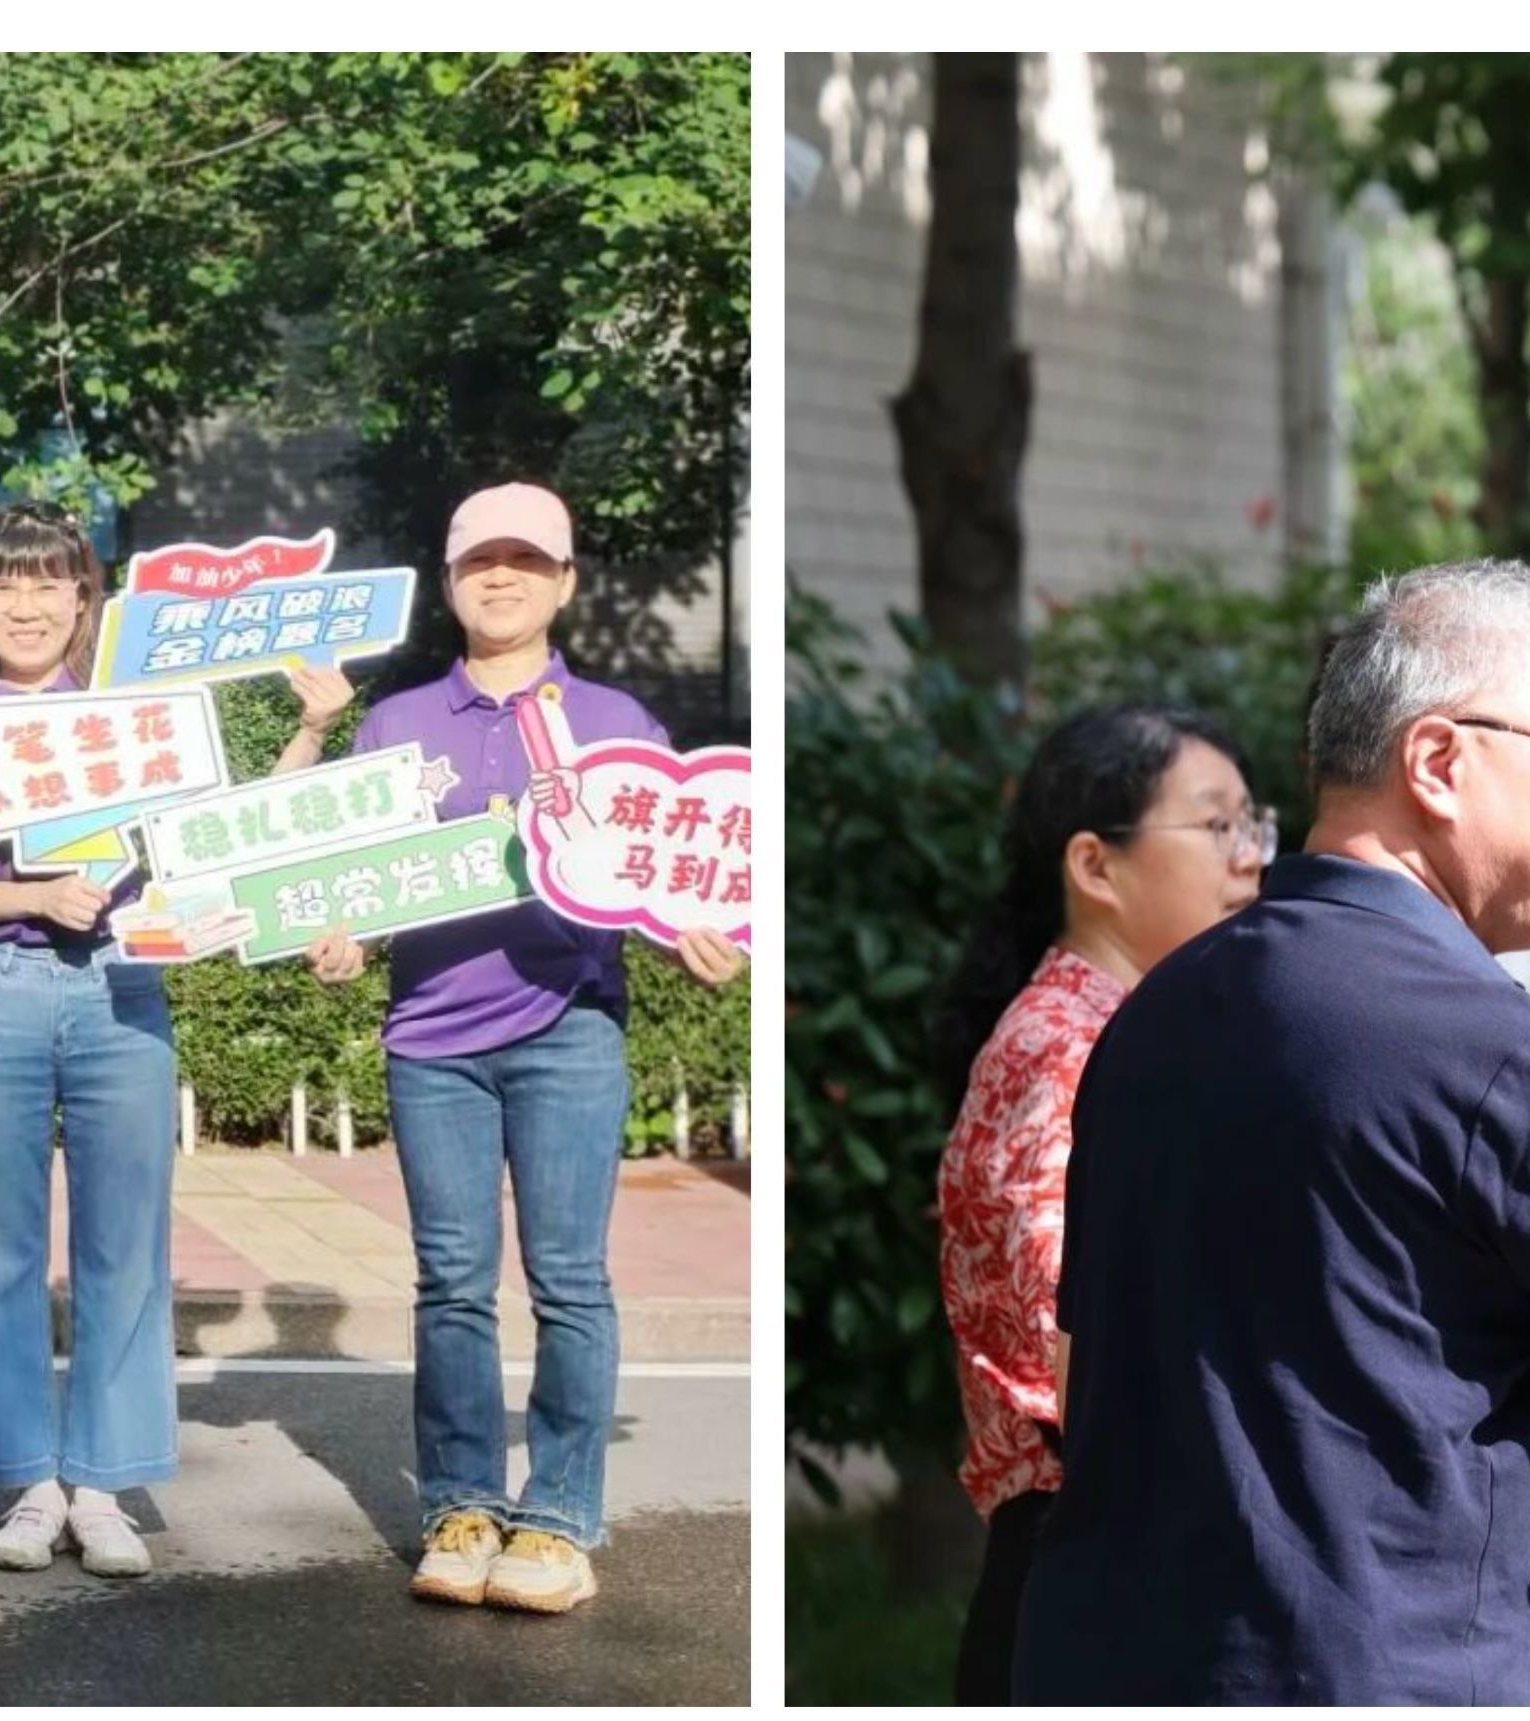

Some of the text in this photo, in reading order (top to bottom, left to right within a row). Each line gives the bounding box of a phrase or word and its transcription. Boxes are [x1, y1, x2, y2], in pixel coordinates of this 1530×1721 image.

[141, 612, 372, 673] 金榜题名
[148, 583, 374, 636] 乘风破浪
[180, 770, 394, 862] 稳扎稳打
[274, 836, 506, 932] 超常发挥
